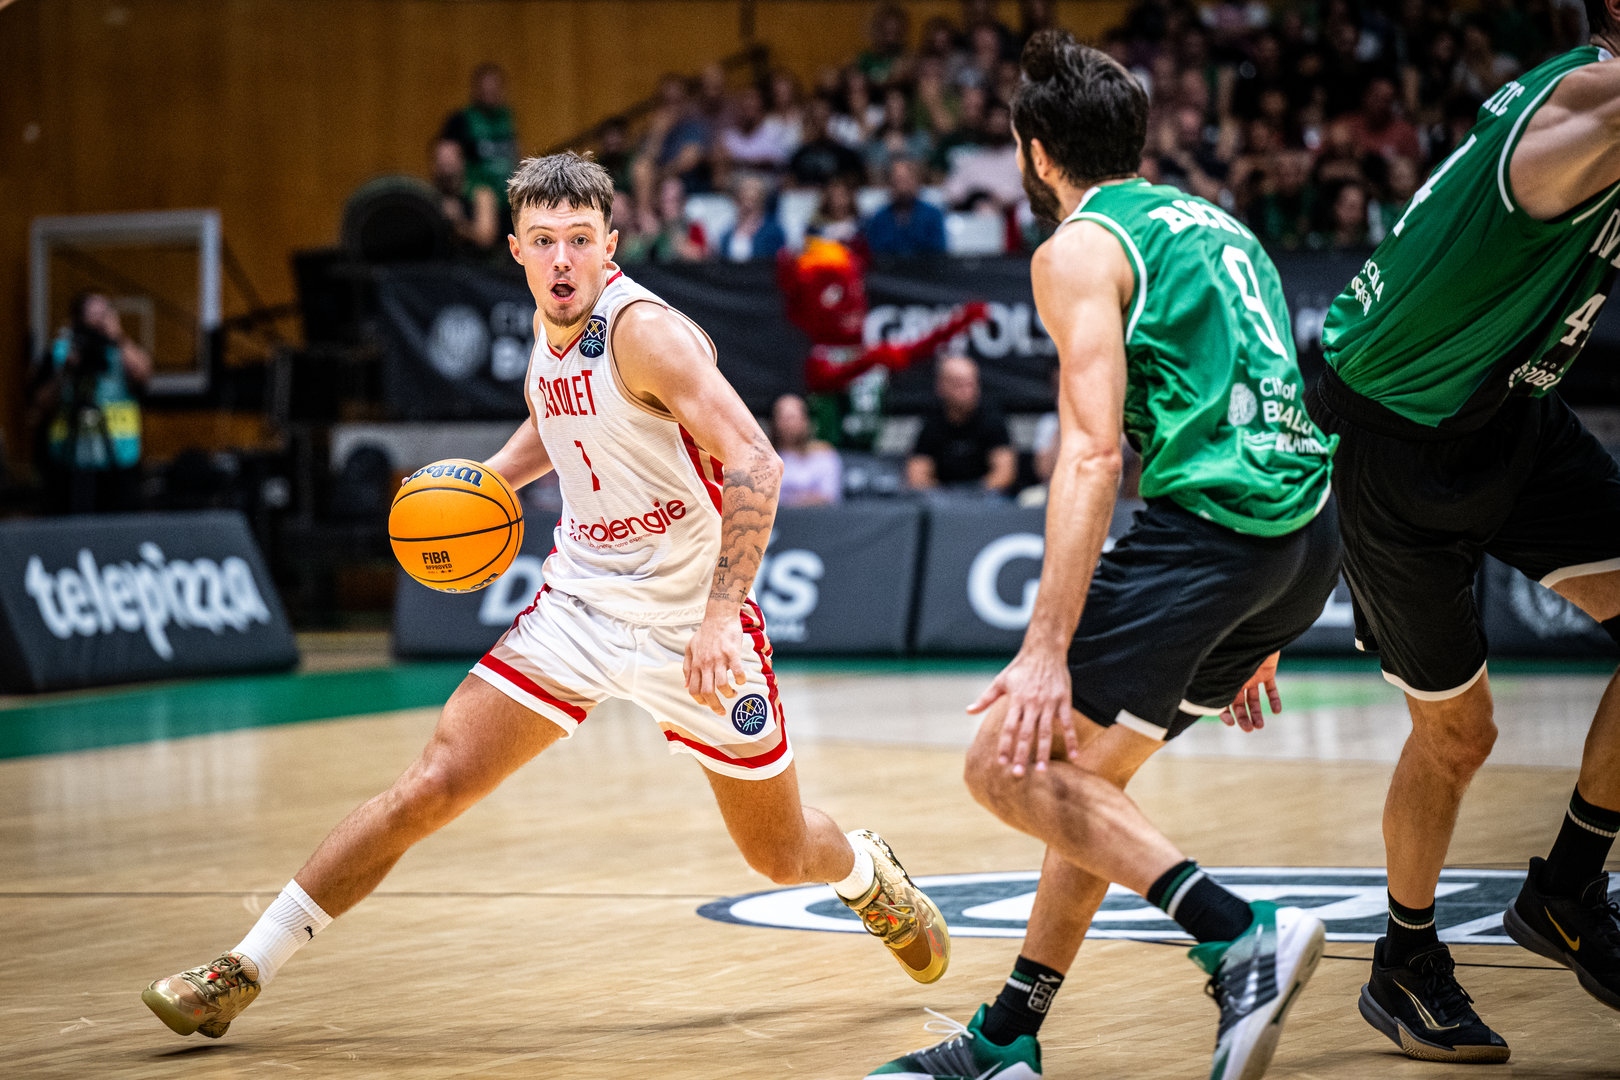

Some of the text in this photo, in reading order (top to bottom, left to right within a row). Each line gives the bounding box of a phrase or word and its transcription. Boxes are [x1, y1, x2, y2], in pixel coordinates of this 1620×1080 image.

[1222, 244, 1289, 362] 9
[574, 440, 601, 491] 1
[421, 550, 451, 565] FIBA
